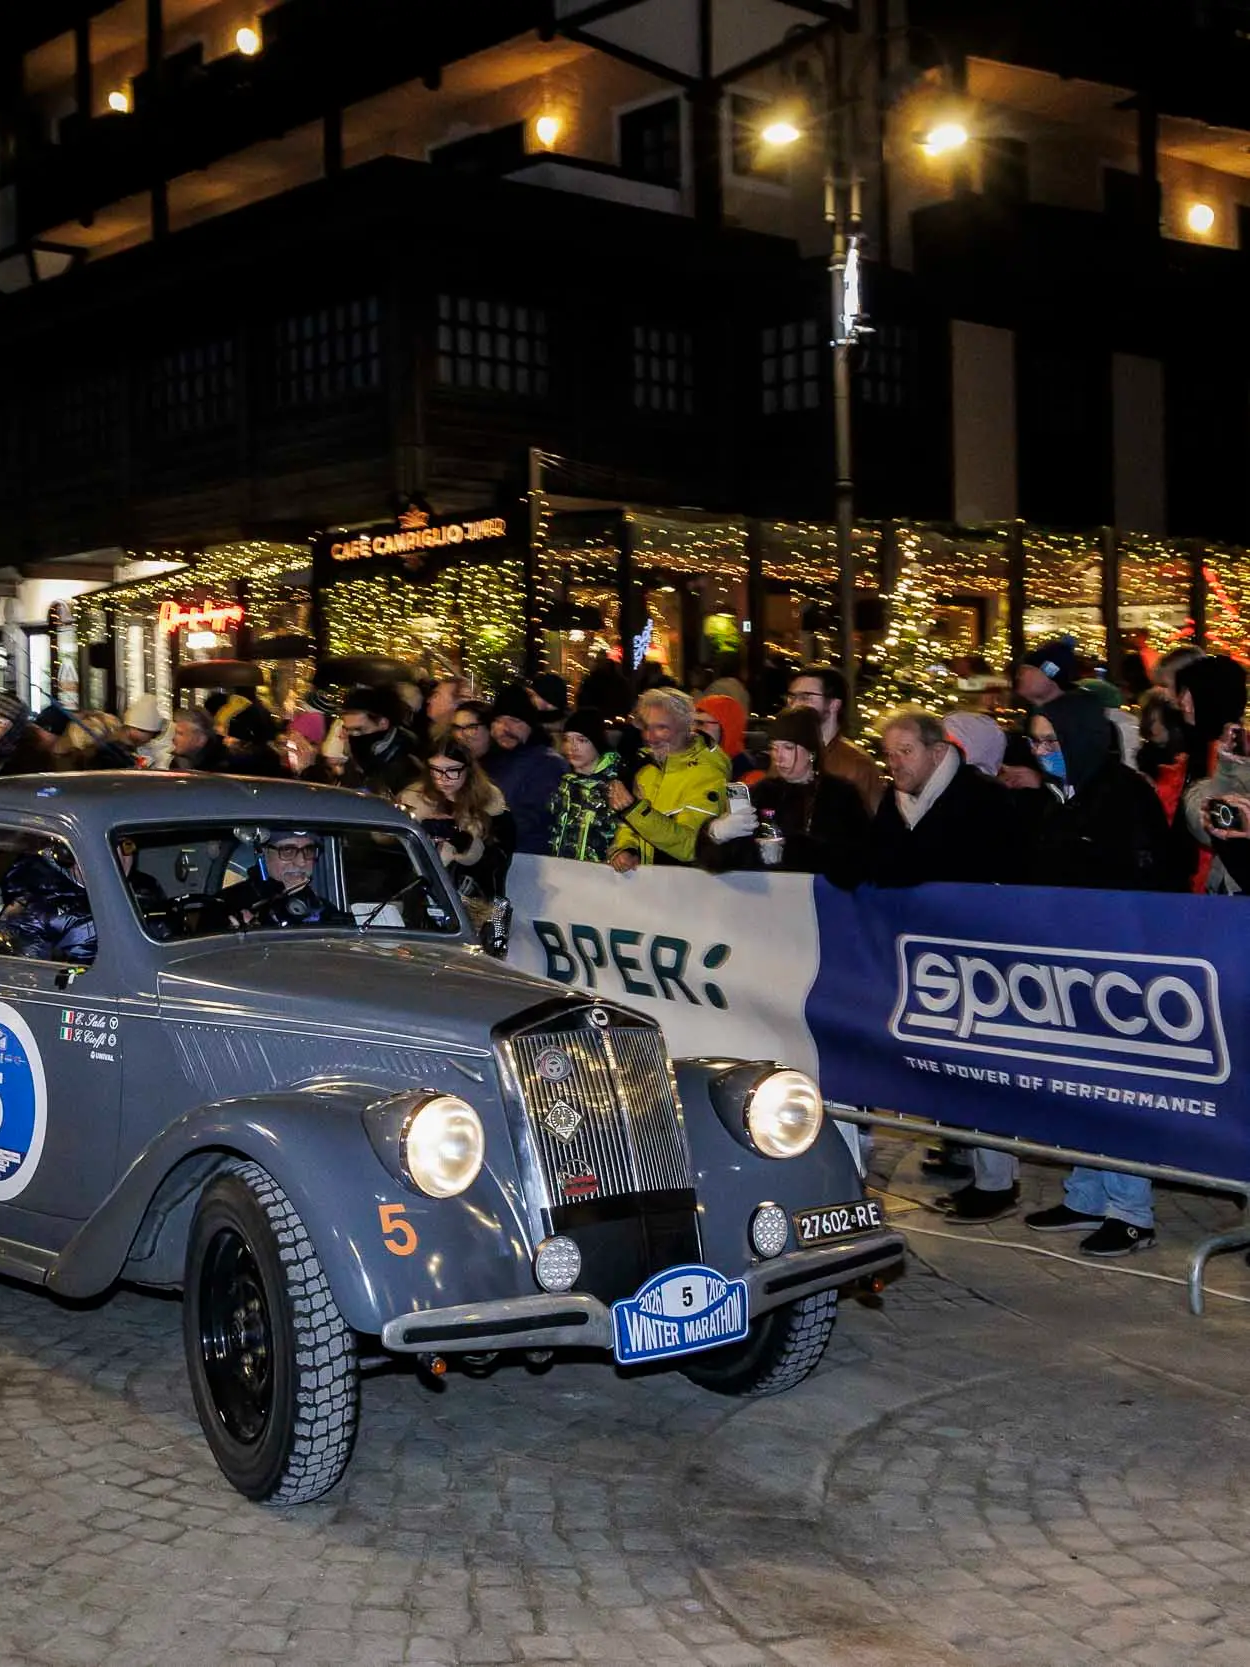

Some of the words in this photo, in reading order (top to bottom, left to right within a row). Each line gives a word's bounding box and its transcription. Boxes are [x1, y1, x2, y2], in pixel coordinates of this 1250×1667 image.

[913, 951, 1206, 1042] sparco
[904, 1056, 940, 1074] THE
[945, 1063, 1011, 1086] POWER
[1017, 1073, 1044, 1092] OF
[1051, 1079, 1218, 1118] PERFORMANCE
[378, 1203, 418, 1256] 5
[623, 1305, 681, 1353] WINTER
[683, 1286, 742, 1344] MARATHON
[639, 1285, 663, 1316] 2026
[681, 1285, 694, 1308] 5
[707, 1275, 727, 1306] 2026
